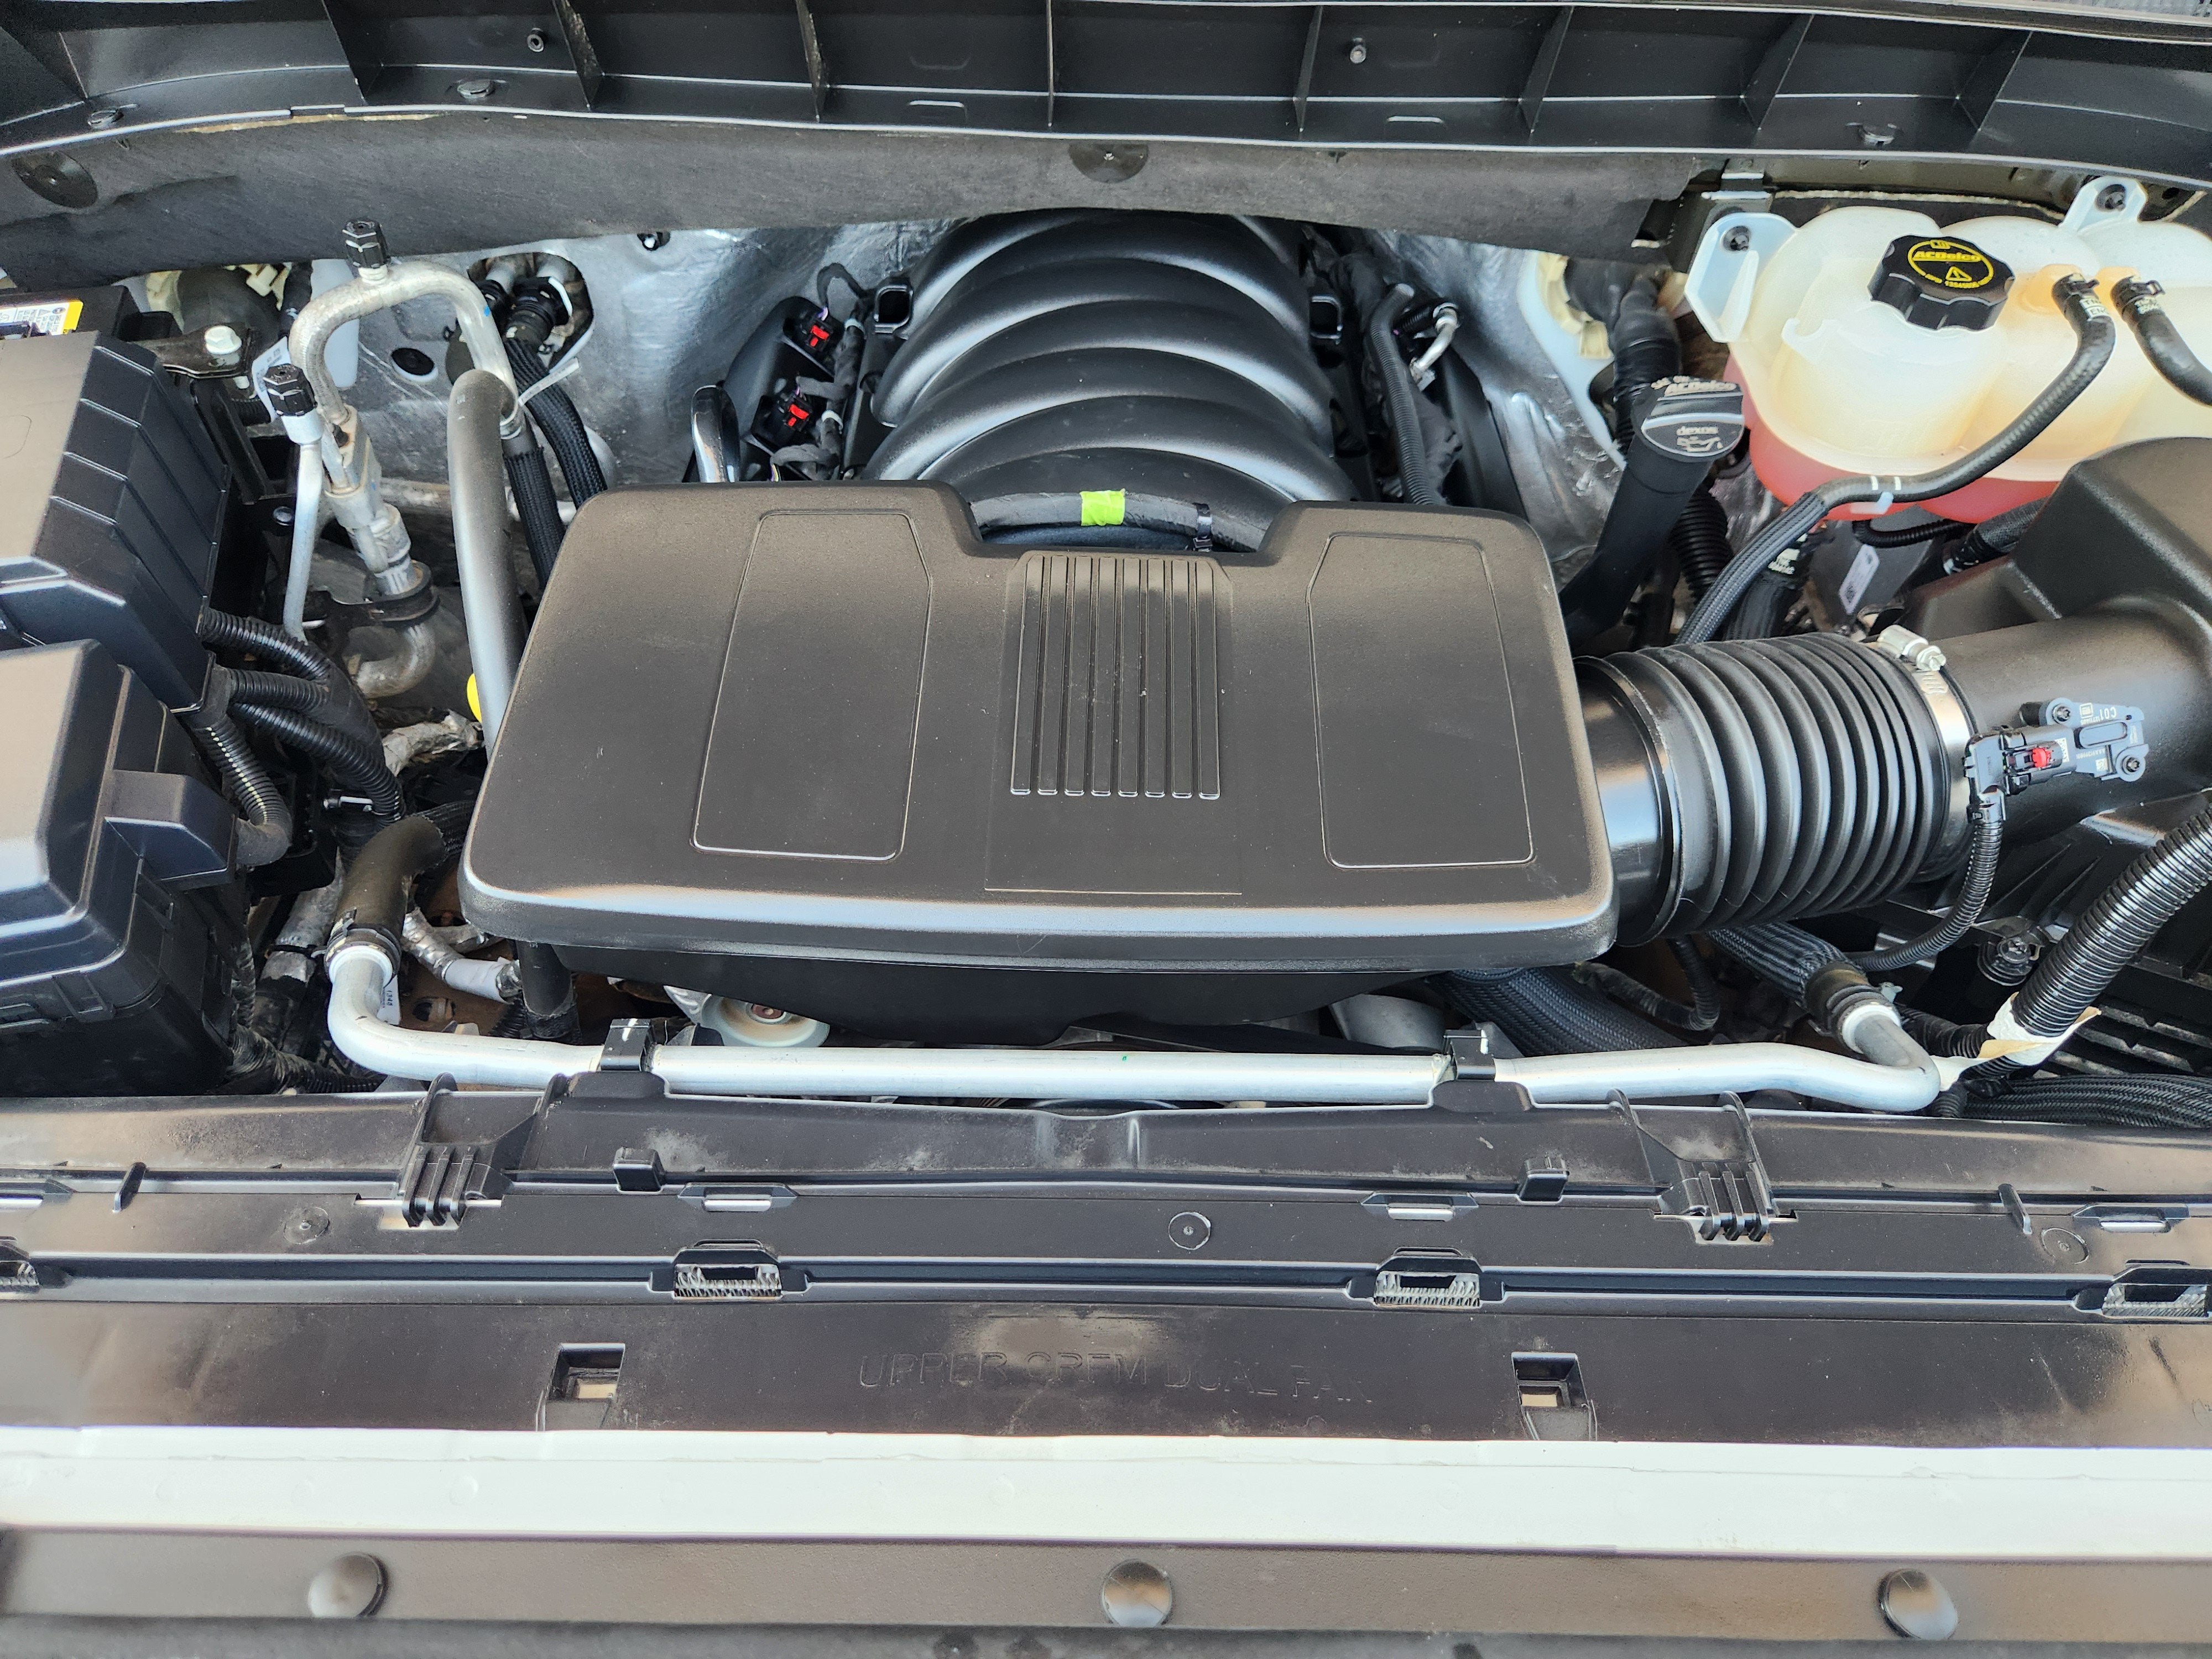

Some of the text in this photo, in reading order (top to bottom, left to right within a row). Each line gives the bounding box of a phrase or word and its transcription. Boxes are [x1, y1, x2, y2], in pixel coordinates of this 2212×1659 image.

[1912, 251, 1981, 262] ACDelco
[1665, 380, 1737, 397] ACDelco
[860, 1352, 1008, 1387] UPPER
